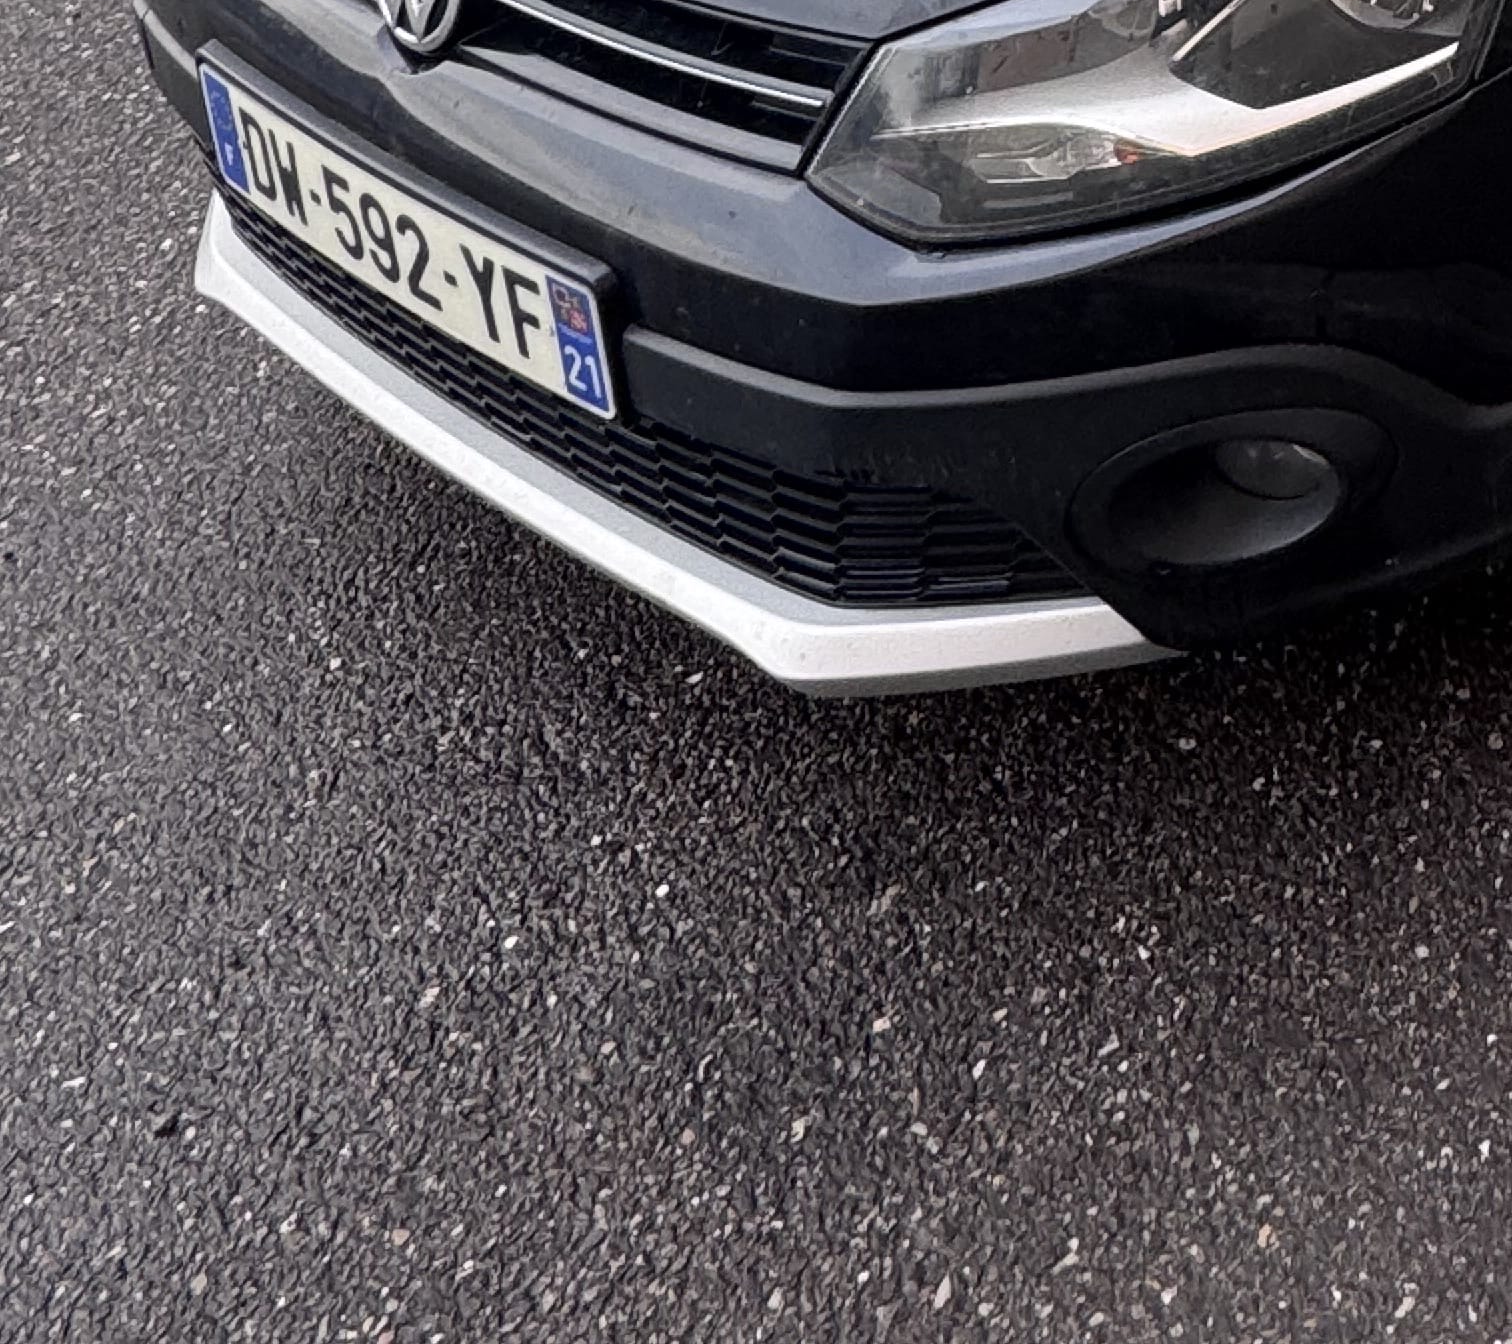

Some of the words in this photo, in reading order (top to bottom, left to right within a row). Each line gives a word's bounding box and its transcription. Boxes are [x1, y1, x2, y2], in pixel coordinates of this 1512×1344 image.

[226, 142, 235, 166] F
[238, 107, 541, 359] DW-592-YF
[563, 344, 603, 399] 21
